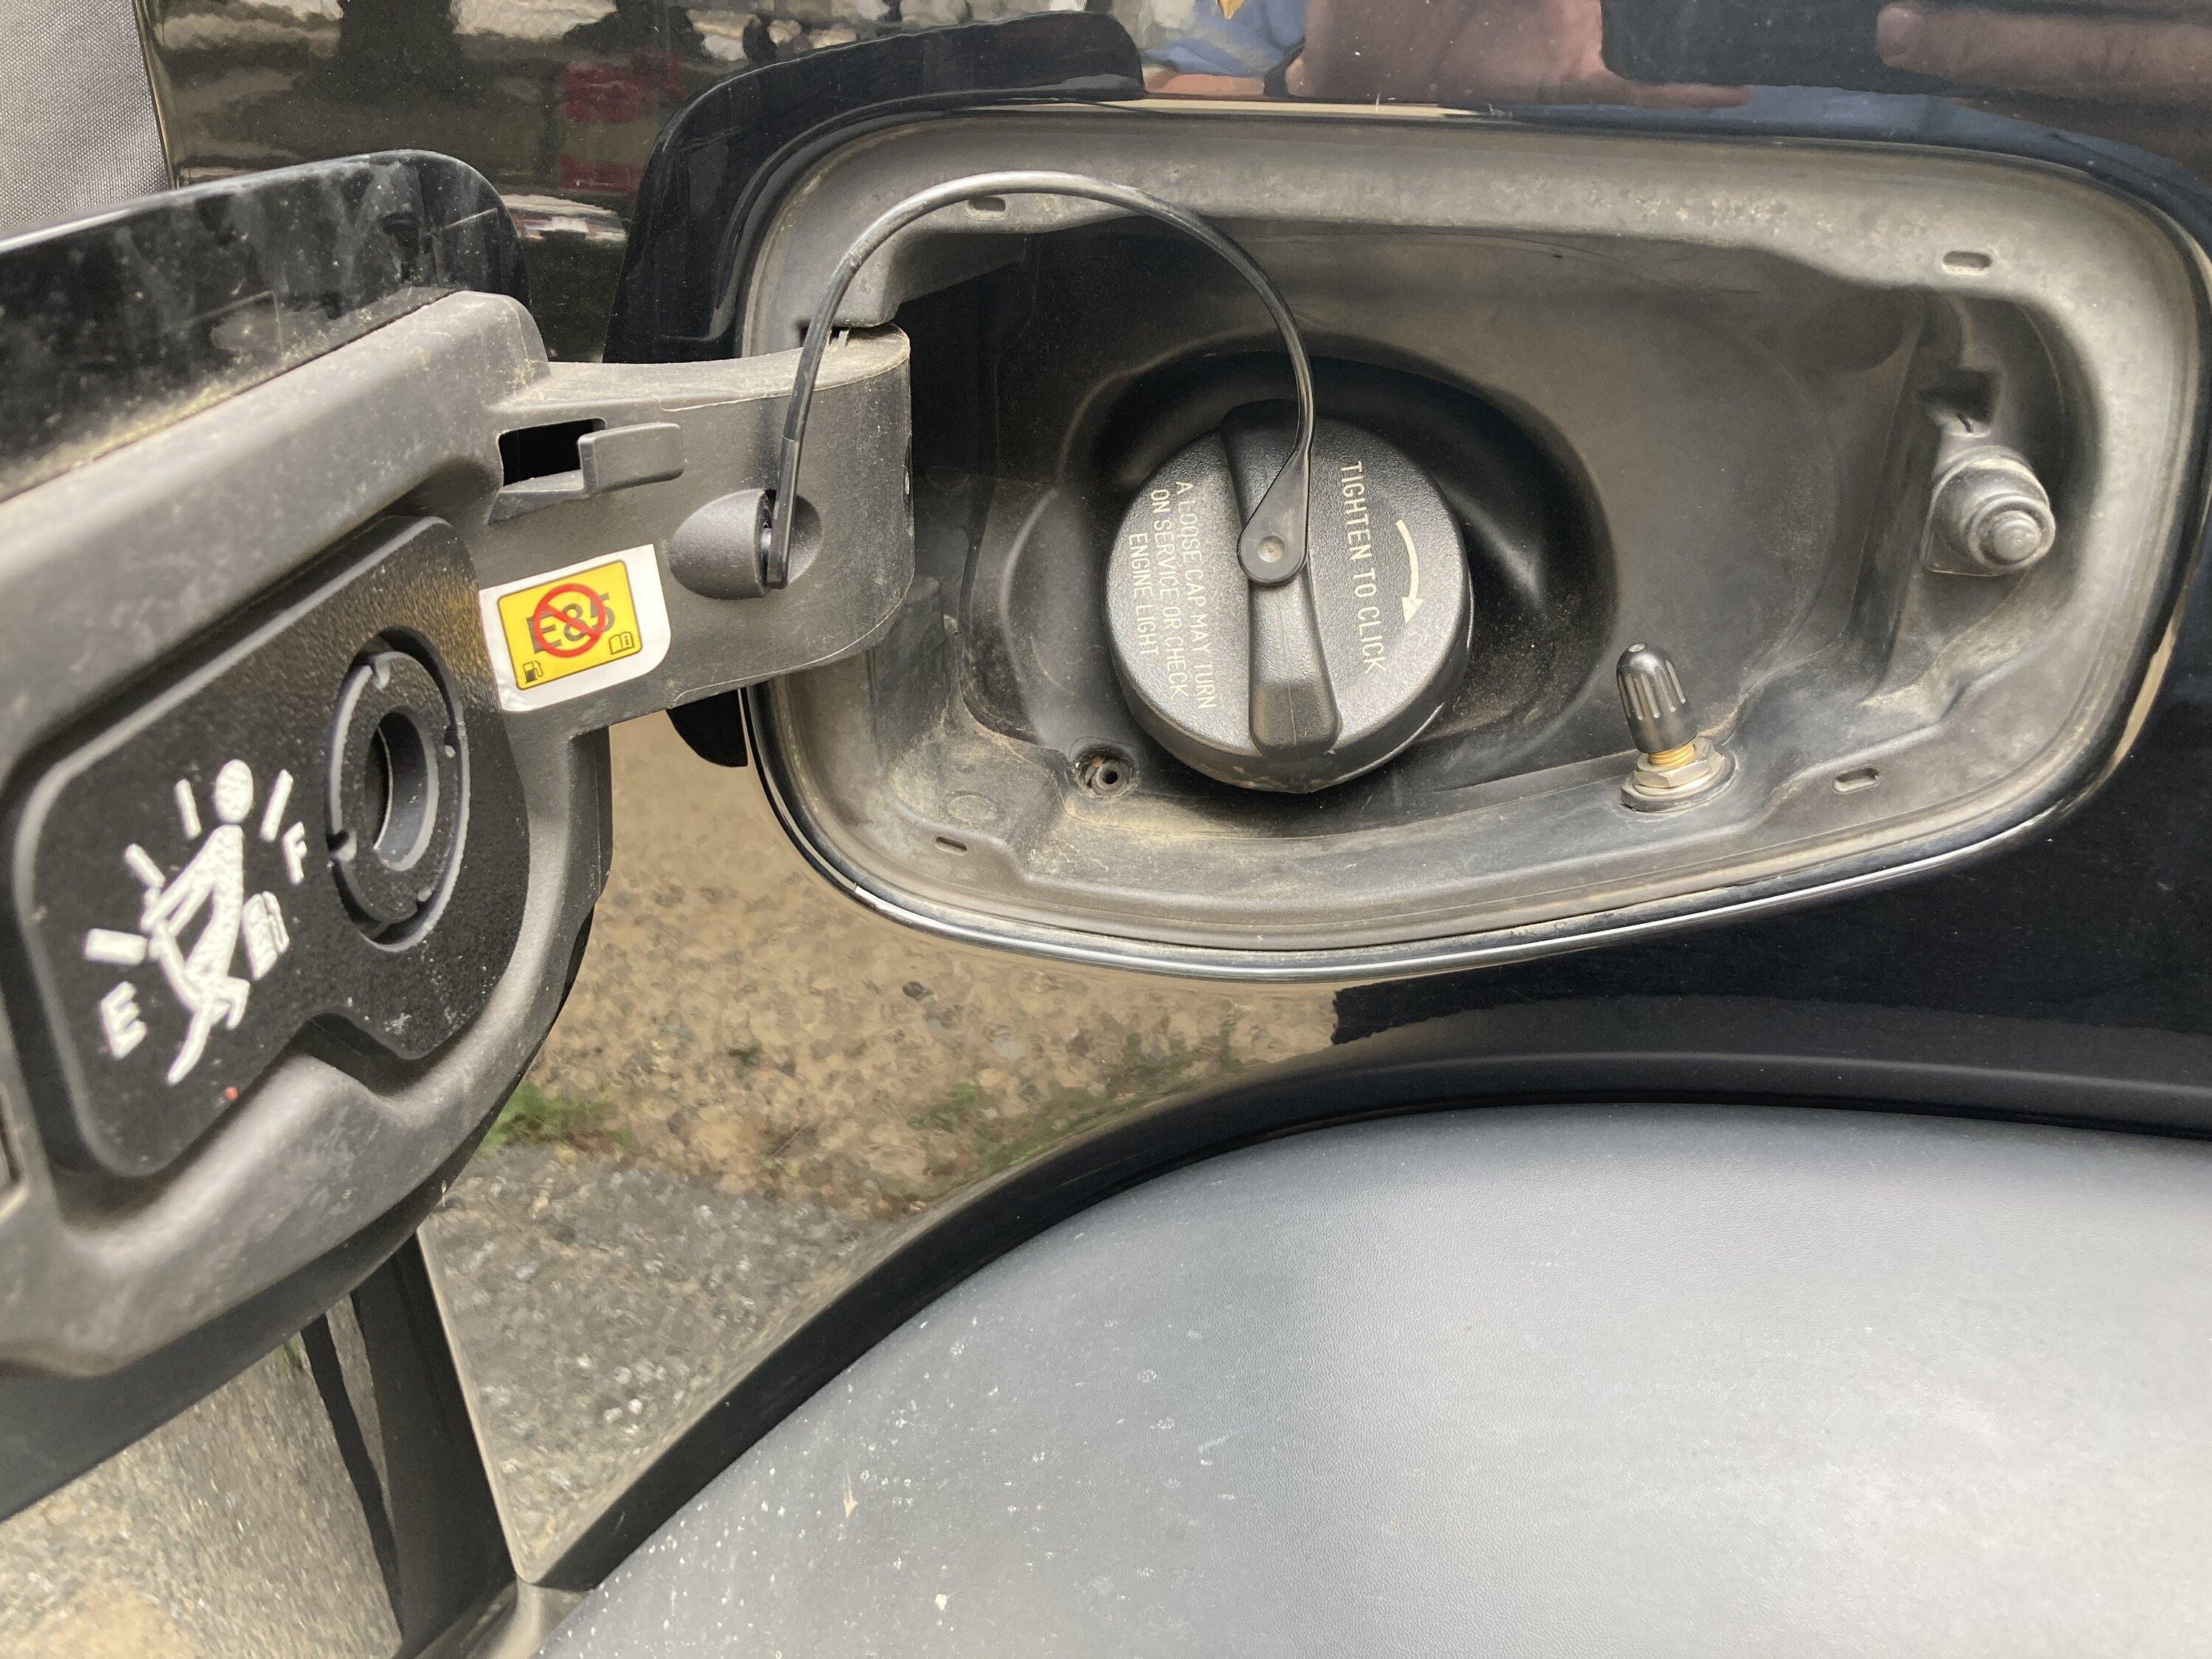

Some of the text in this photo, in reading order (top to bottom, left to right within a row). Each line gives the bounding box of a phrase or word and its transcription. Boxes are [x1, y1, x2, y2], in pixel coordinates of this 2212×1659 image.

[1129, 532, 1159, 655] ENGINE LIGHT
[1150, 489, 1189, 700] ON SERVICE OR CHECK
[1175, 481, 1217, 709] A LOOSE CAP MAY TURN
[1340, 461, 1387, 674] TIGHTEN TO CLICK
[100, 980, 147, 1059] E
